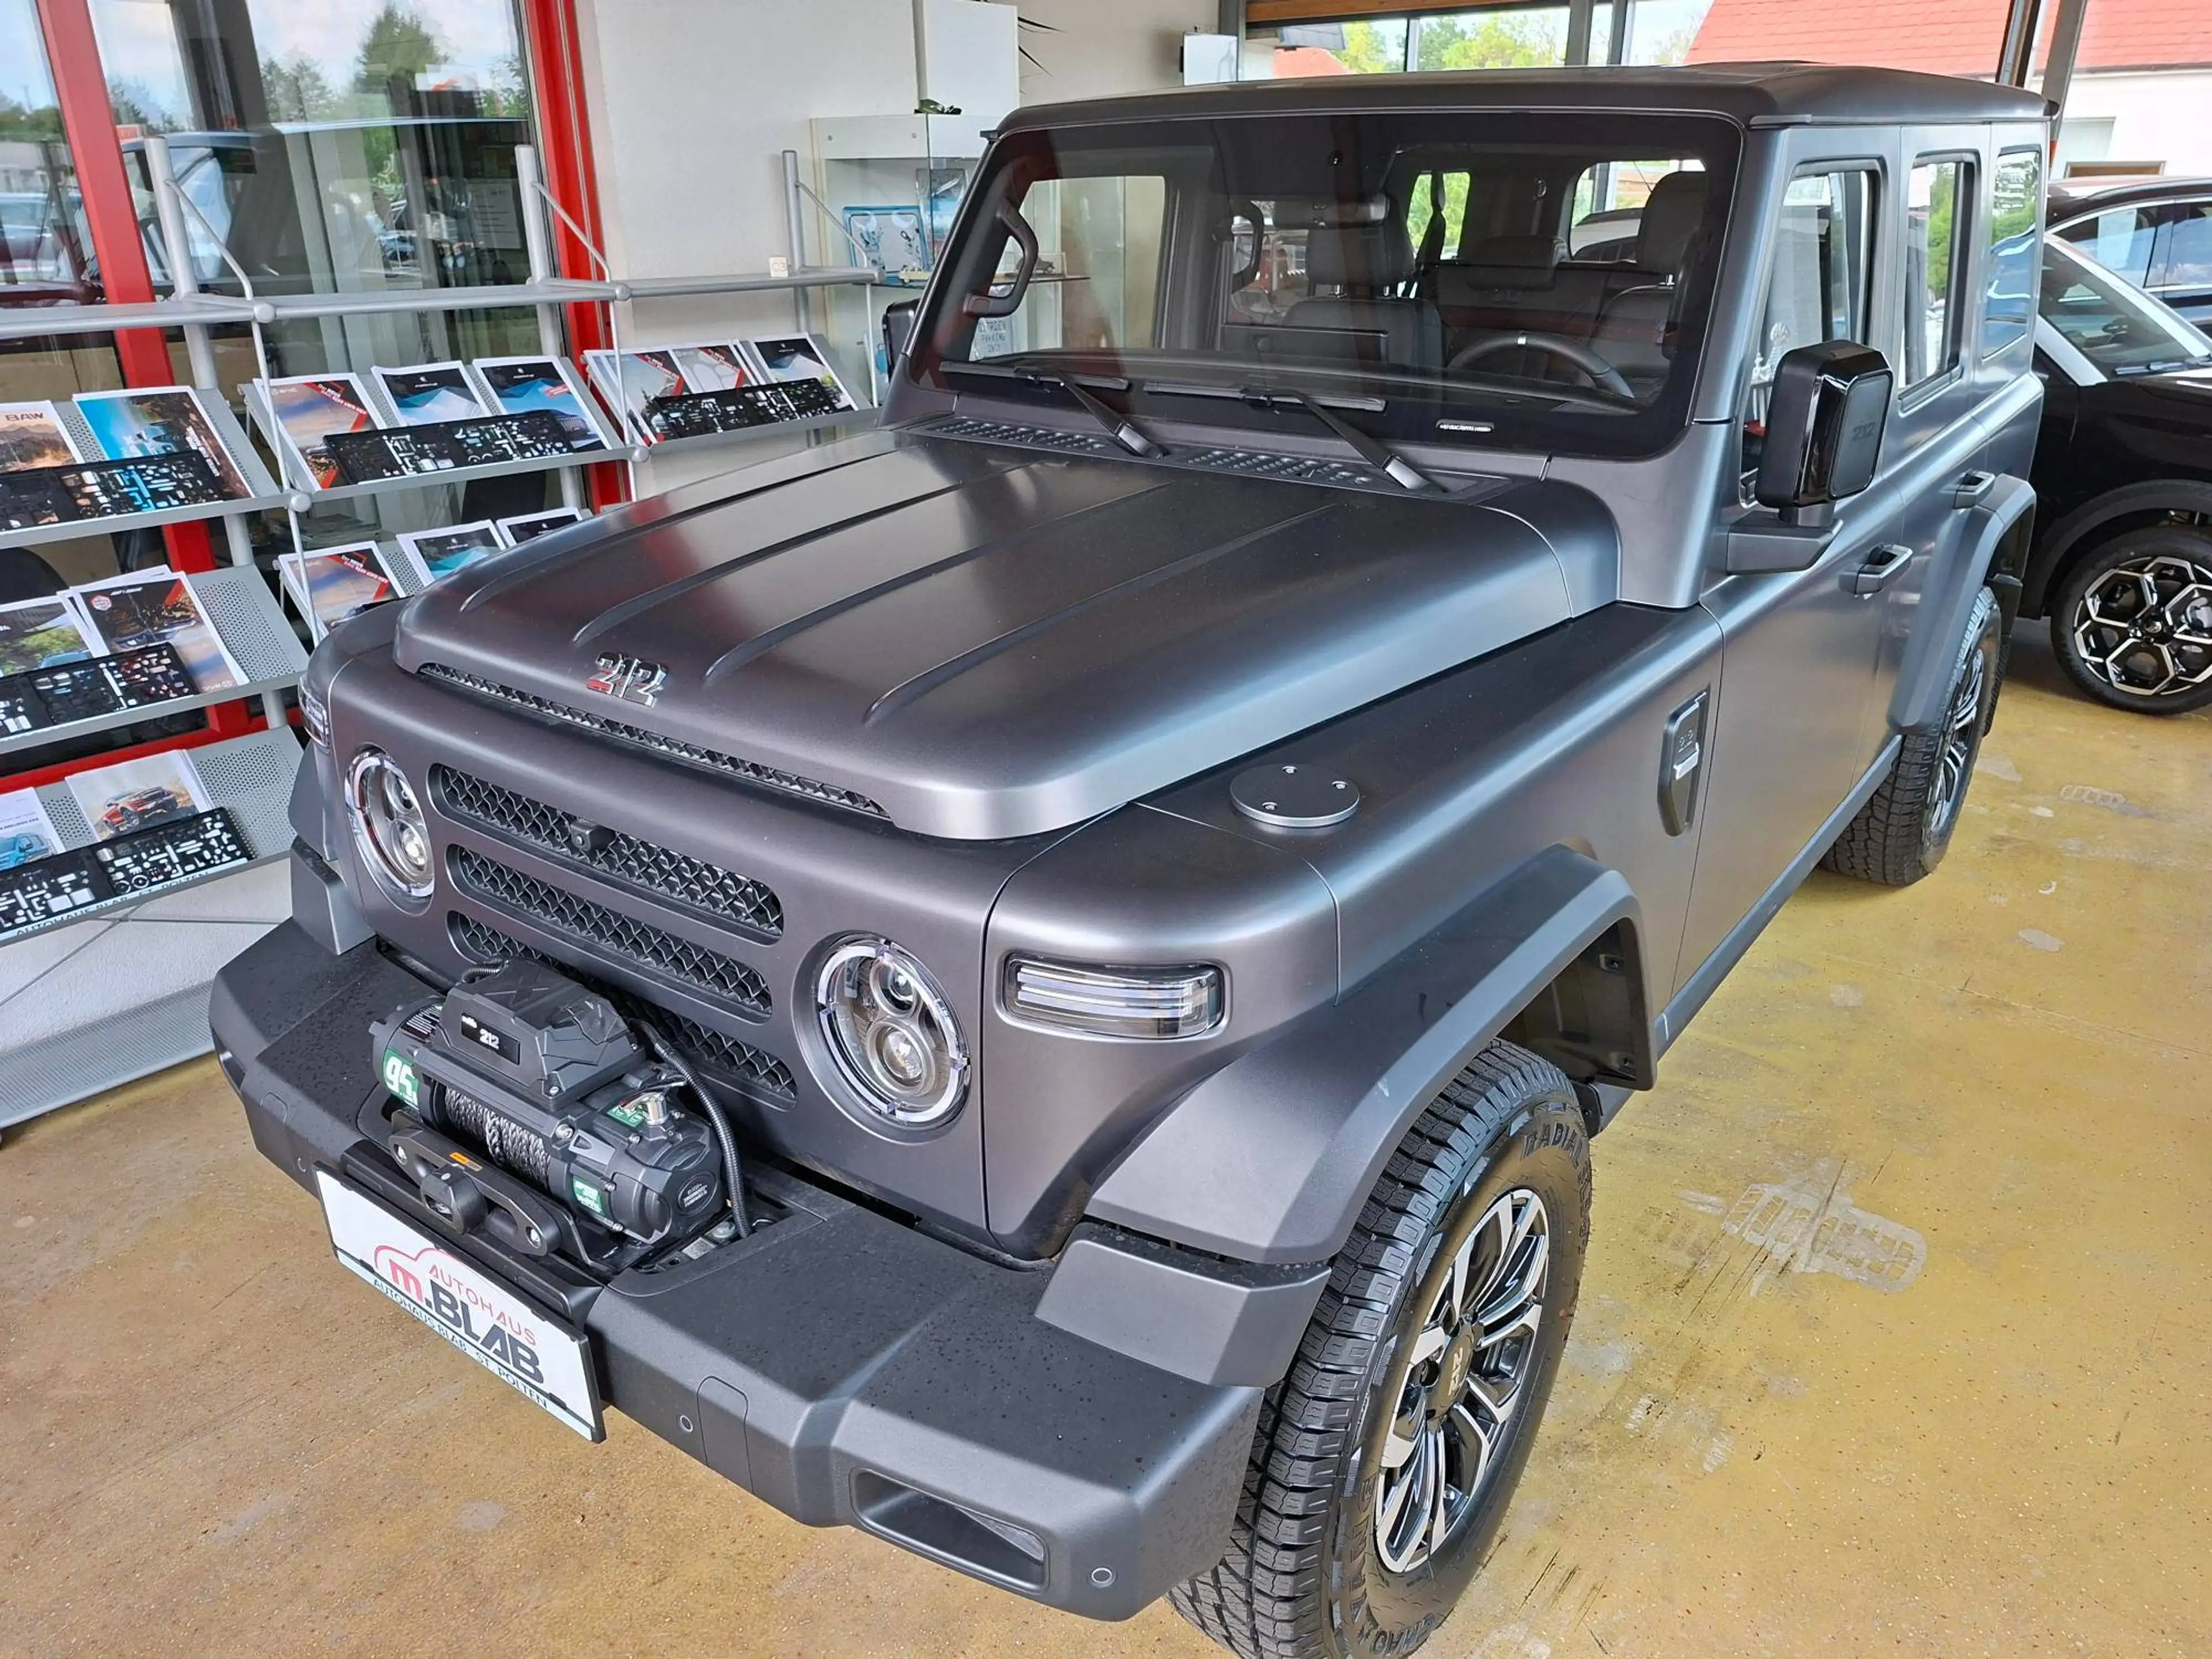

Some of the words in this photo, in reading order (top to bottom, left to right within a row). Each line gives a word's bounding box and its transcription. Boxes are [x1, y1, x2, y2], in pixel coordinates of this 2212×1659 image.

[5, 412, 44, 421] BAW
[1851, 421, 1876, 442] 212
[585, 652, 667, 707] 212
[479, 1028, 500, 1050] 212
[1522, 1120, 1583, 1170] RADIAL
[373, 1279, 434, 1330] AUTOHAUS
[438, 1324, 467, 1351] BLAB
[429, 1264, 537, 1347] AUTOHAUS
